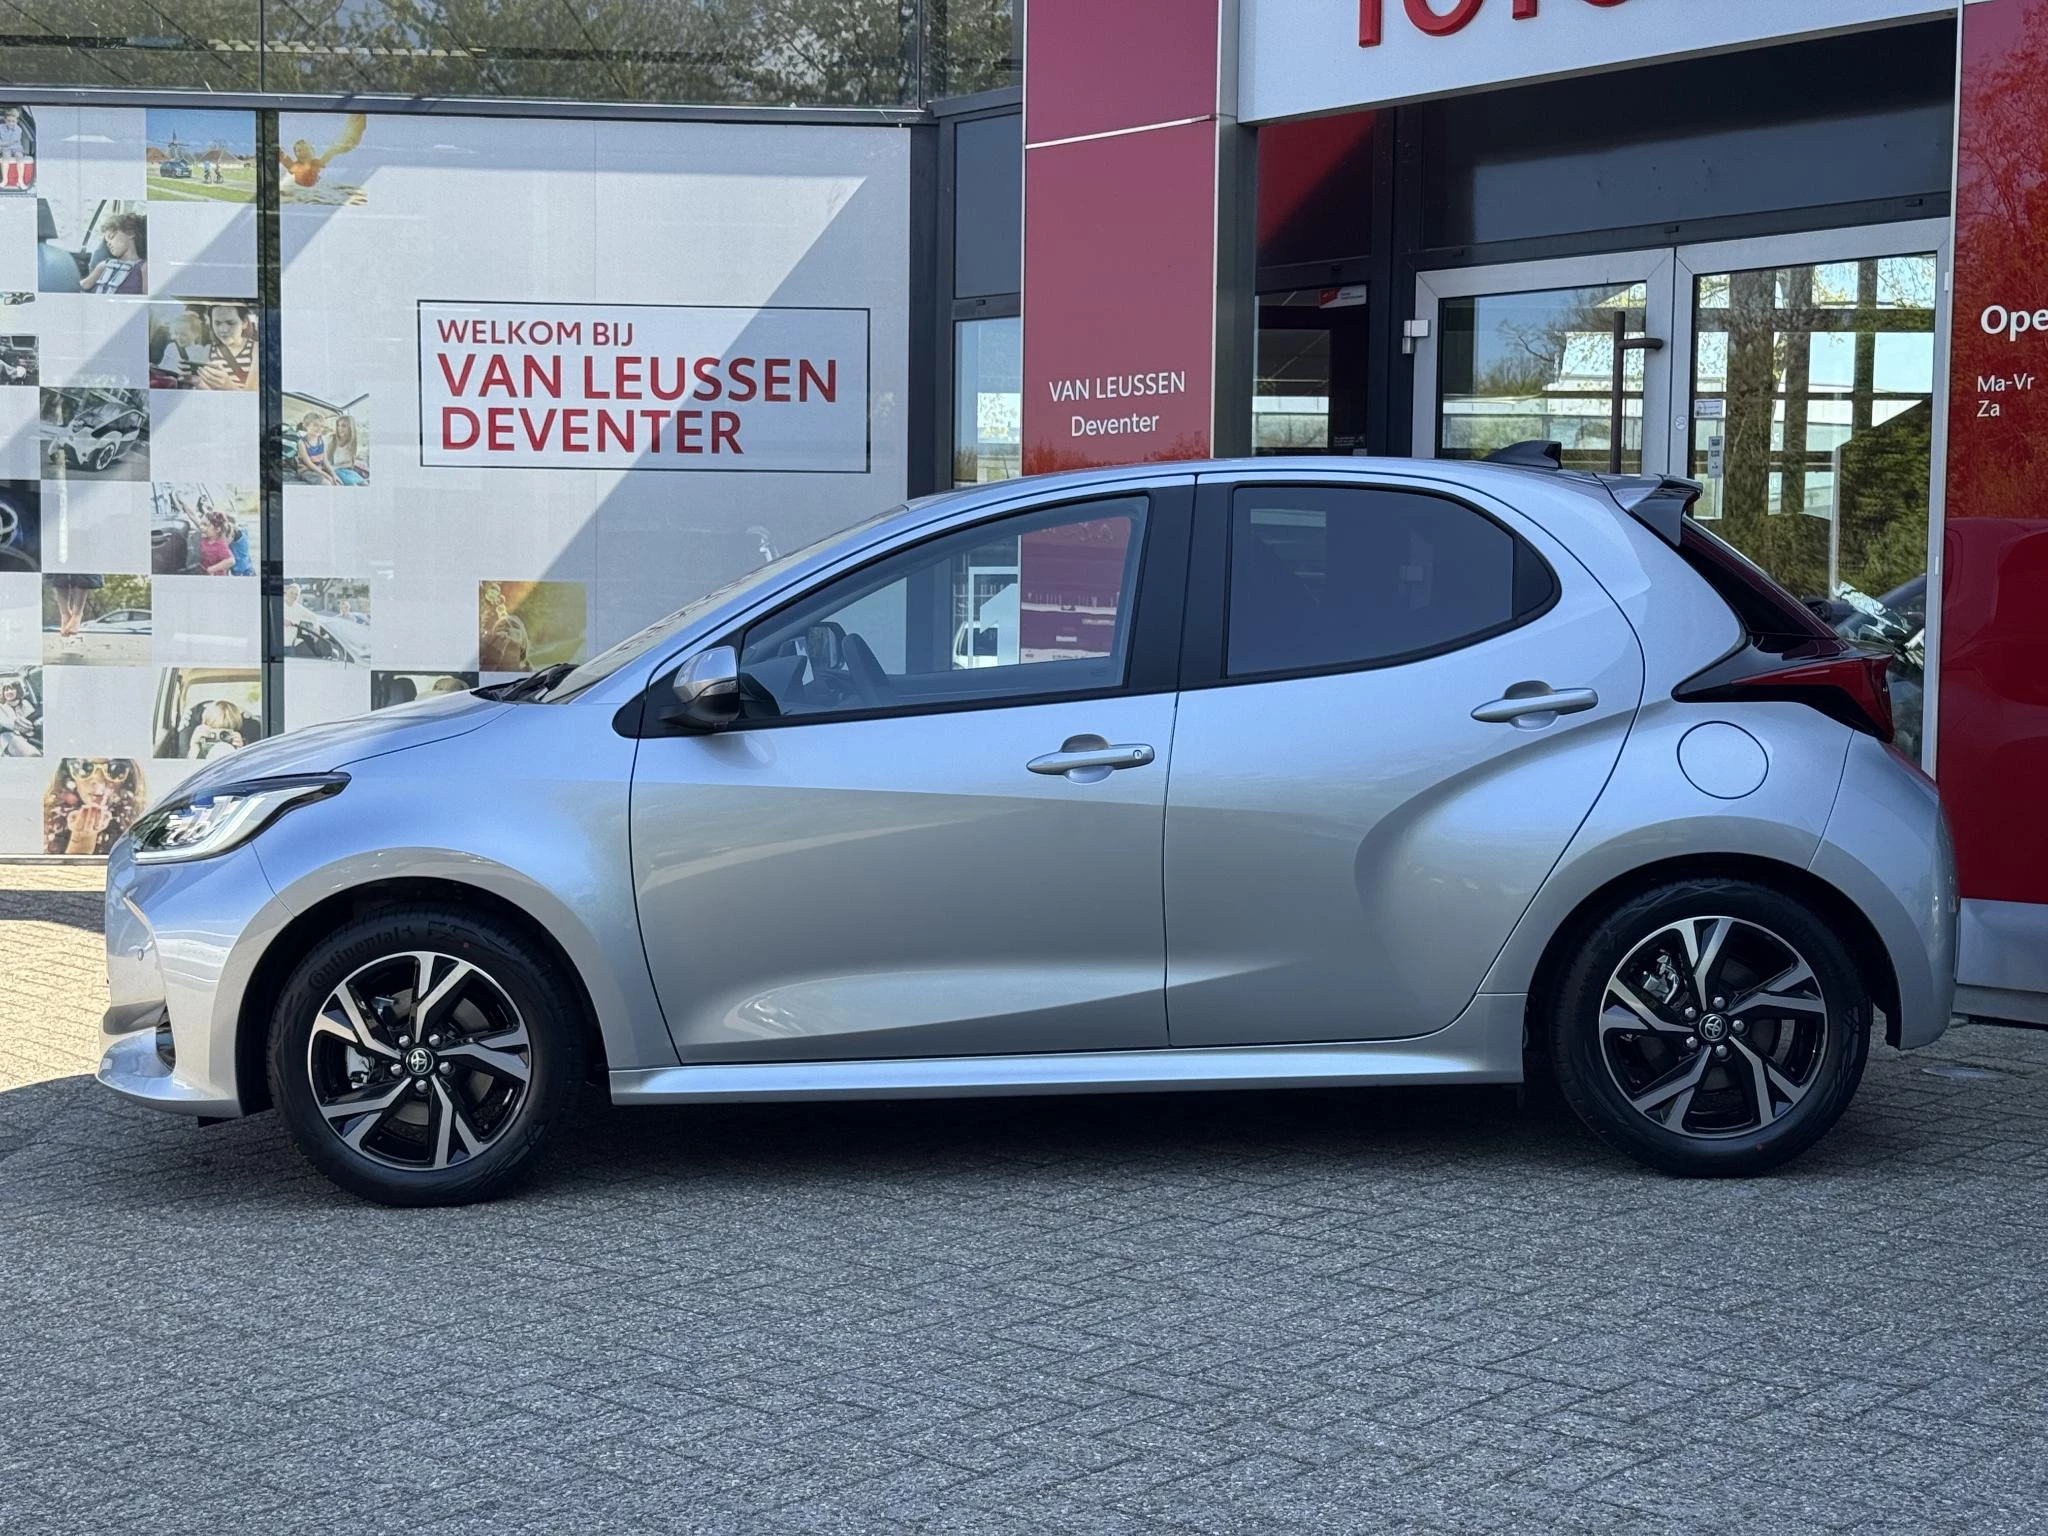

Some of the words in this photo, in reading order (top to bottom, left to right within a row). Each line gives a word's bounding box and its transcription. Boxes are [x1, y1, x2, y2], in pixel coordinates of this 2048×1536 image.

[436, 319, 582, 346] WELKOM
[593, 322, 633, 347] BIJ
[437, 353, 562, 399] VAN
[584, 355, 837, 403] LEUSSEN
[1049, 378, 1090, 402] VAN
[1096, 371, 1186, 399] LEUSSEN
[1977, 372, 2036, 393] Ma-Vr
[1976, 399, 2001, 418] Za
[441, 406, 744, 455] DEVENTER
[1071, 412, 1160, 437] Deventer
